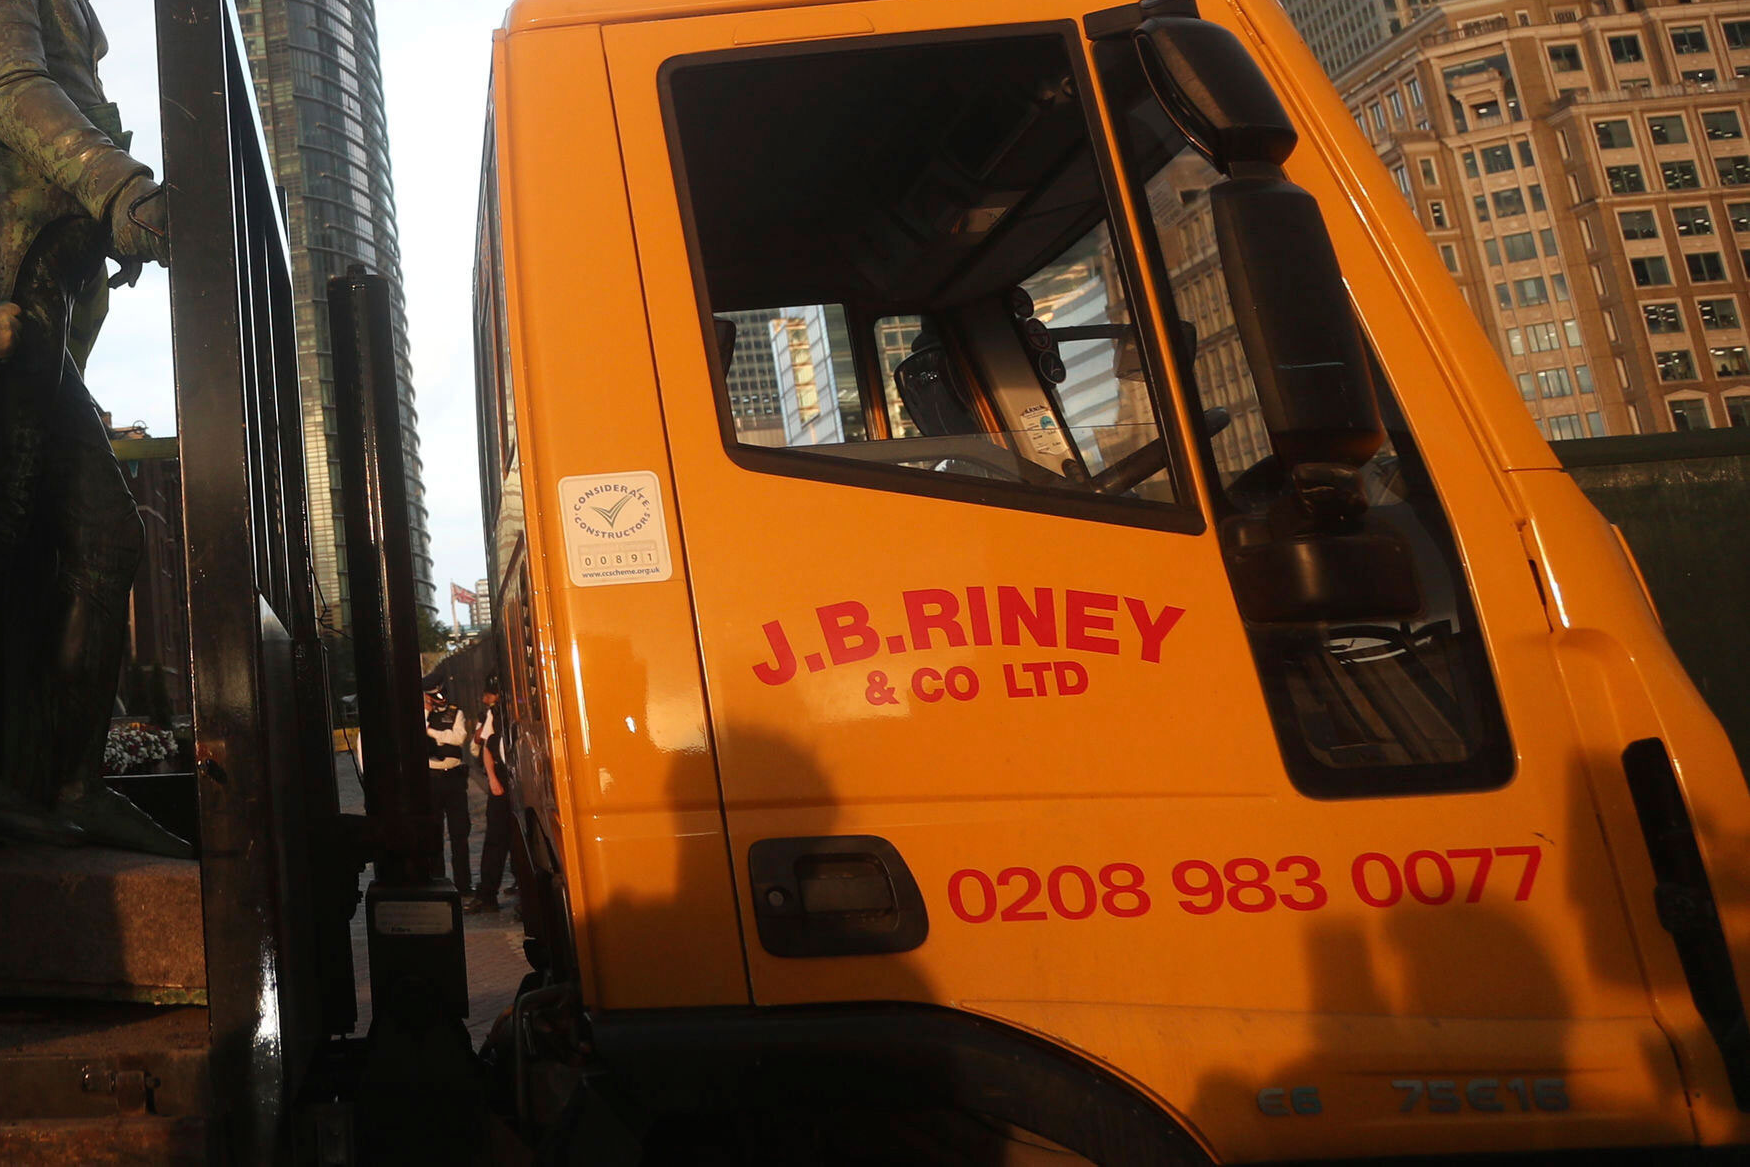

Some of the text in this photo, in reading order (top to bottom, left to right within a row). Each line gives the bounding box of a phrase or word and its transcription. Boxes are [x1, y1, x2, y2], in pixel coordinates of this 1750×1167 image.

[573, 484, 650, 512] CONSIDERATE
[574, 512, 651, 539] CONSTRUCTORS
[581, 566, 660, 579] www.ccscheme.org.uk
[751, 585, 1187, 687] J.B.RINEY
[865, 660, 1089, 706] & CO LTD
[947, 844, 1543, 924] 0208 983 0077
